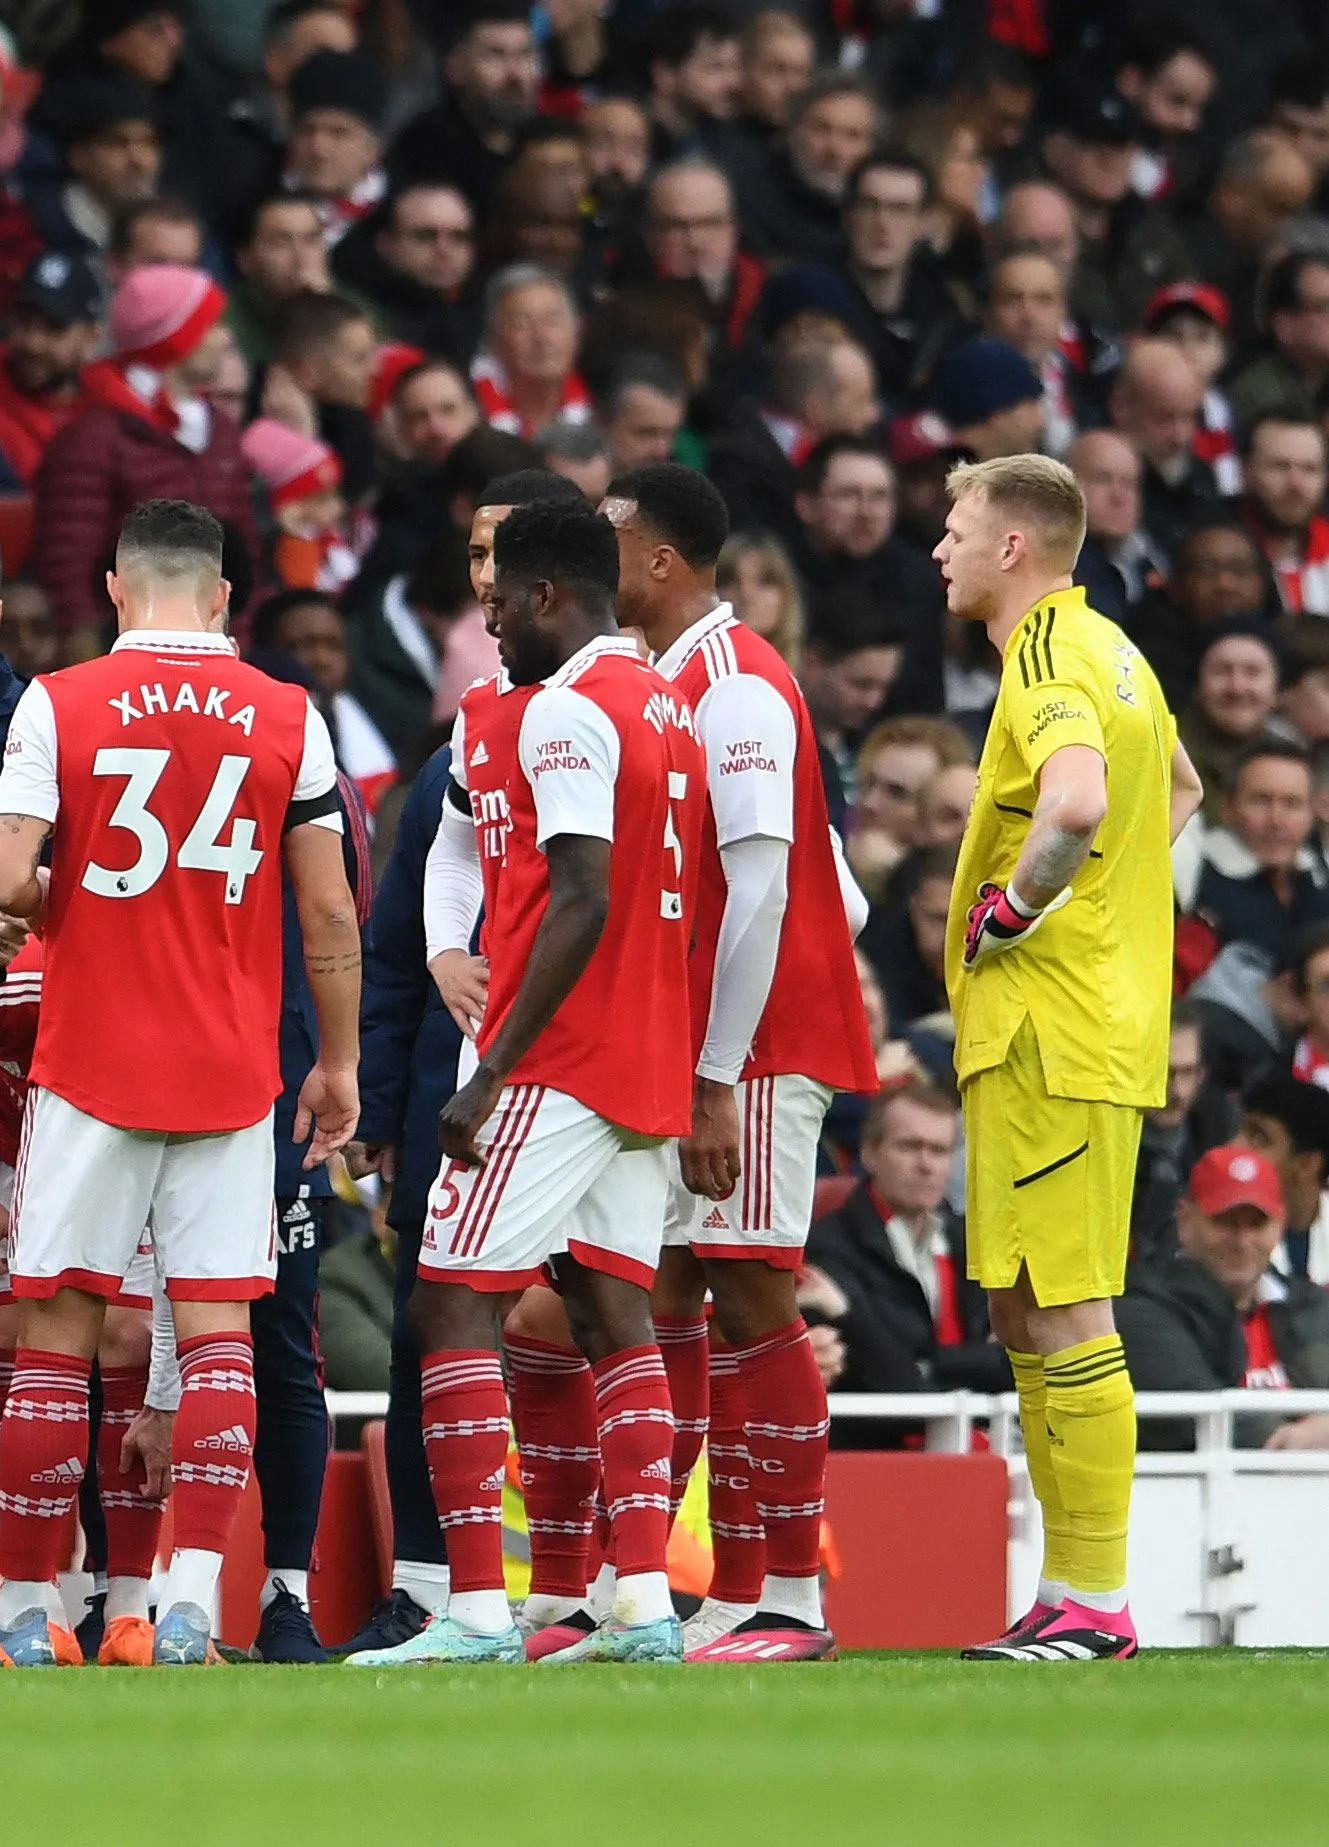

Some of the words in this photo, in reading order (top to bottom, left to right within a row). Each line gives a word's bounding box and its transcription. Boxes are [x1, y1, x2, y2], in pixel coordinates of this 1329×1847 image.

[108, 683, 256, 737] XHAKA
[1033, 701, 1067, 721] VISIT
[1027, 711, 1087, 746] RWANDA
[535, 740, 572, 756] VISIT
[726, 741, 763, 756] VISIT
[719, 757, 777, 776] RWANDA
[81, 747, 265, 905] 34
[431, 1158, 470, 1219] 5
